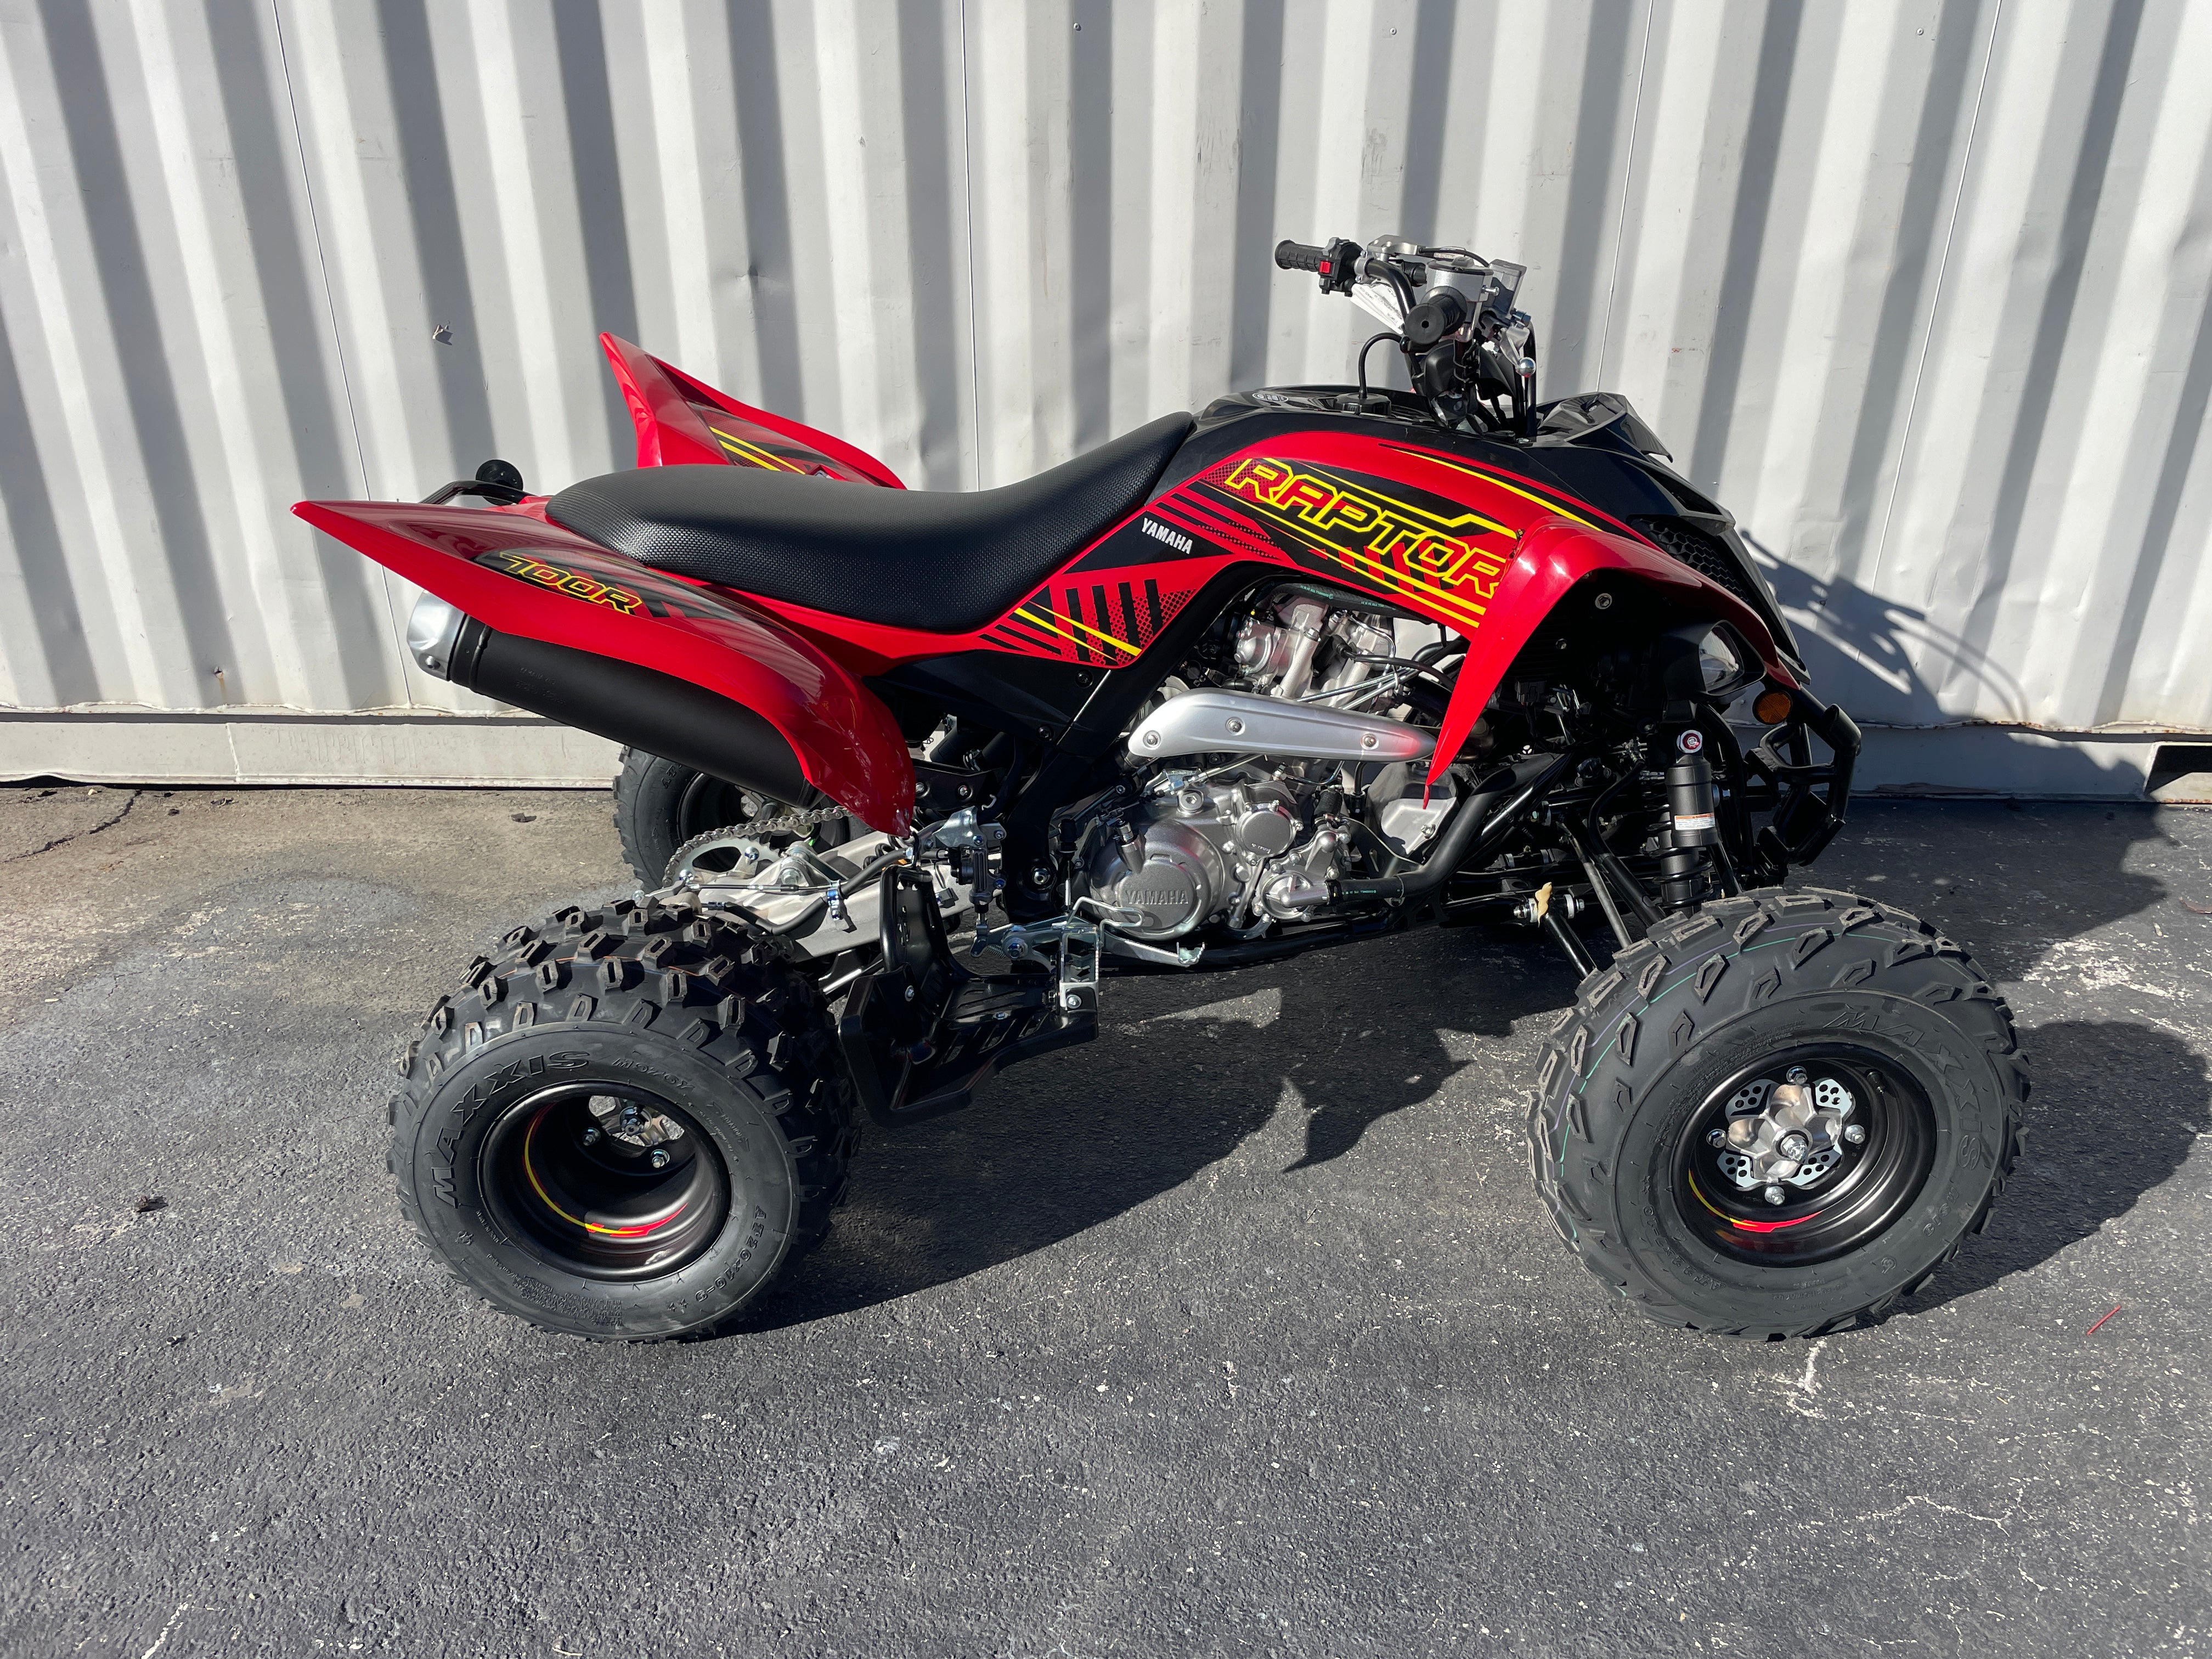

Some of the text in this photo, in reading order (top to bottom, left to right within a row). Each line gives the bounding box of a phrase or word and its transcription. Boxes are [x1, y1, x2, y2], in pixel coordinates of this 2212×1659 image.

[1141, 517, 1194, 555] YAMAHA
[1224, 458, 1506, 599] RAPTOR
[500, 551, 642, 614] 700R
[1125, 889, 1189, 906] YAMAHA
[431, 1051, 590, 1209] MAXXIS
[1822, 1011, 1982, 1170] MAXXIS
